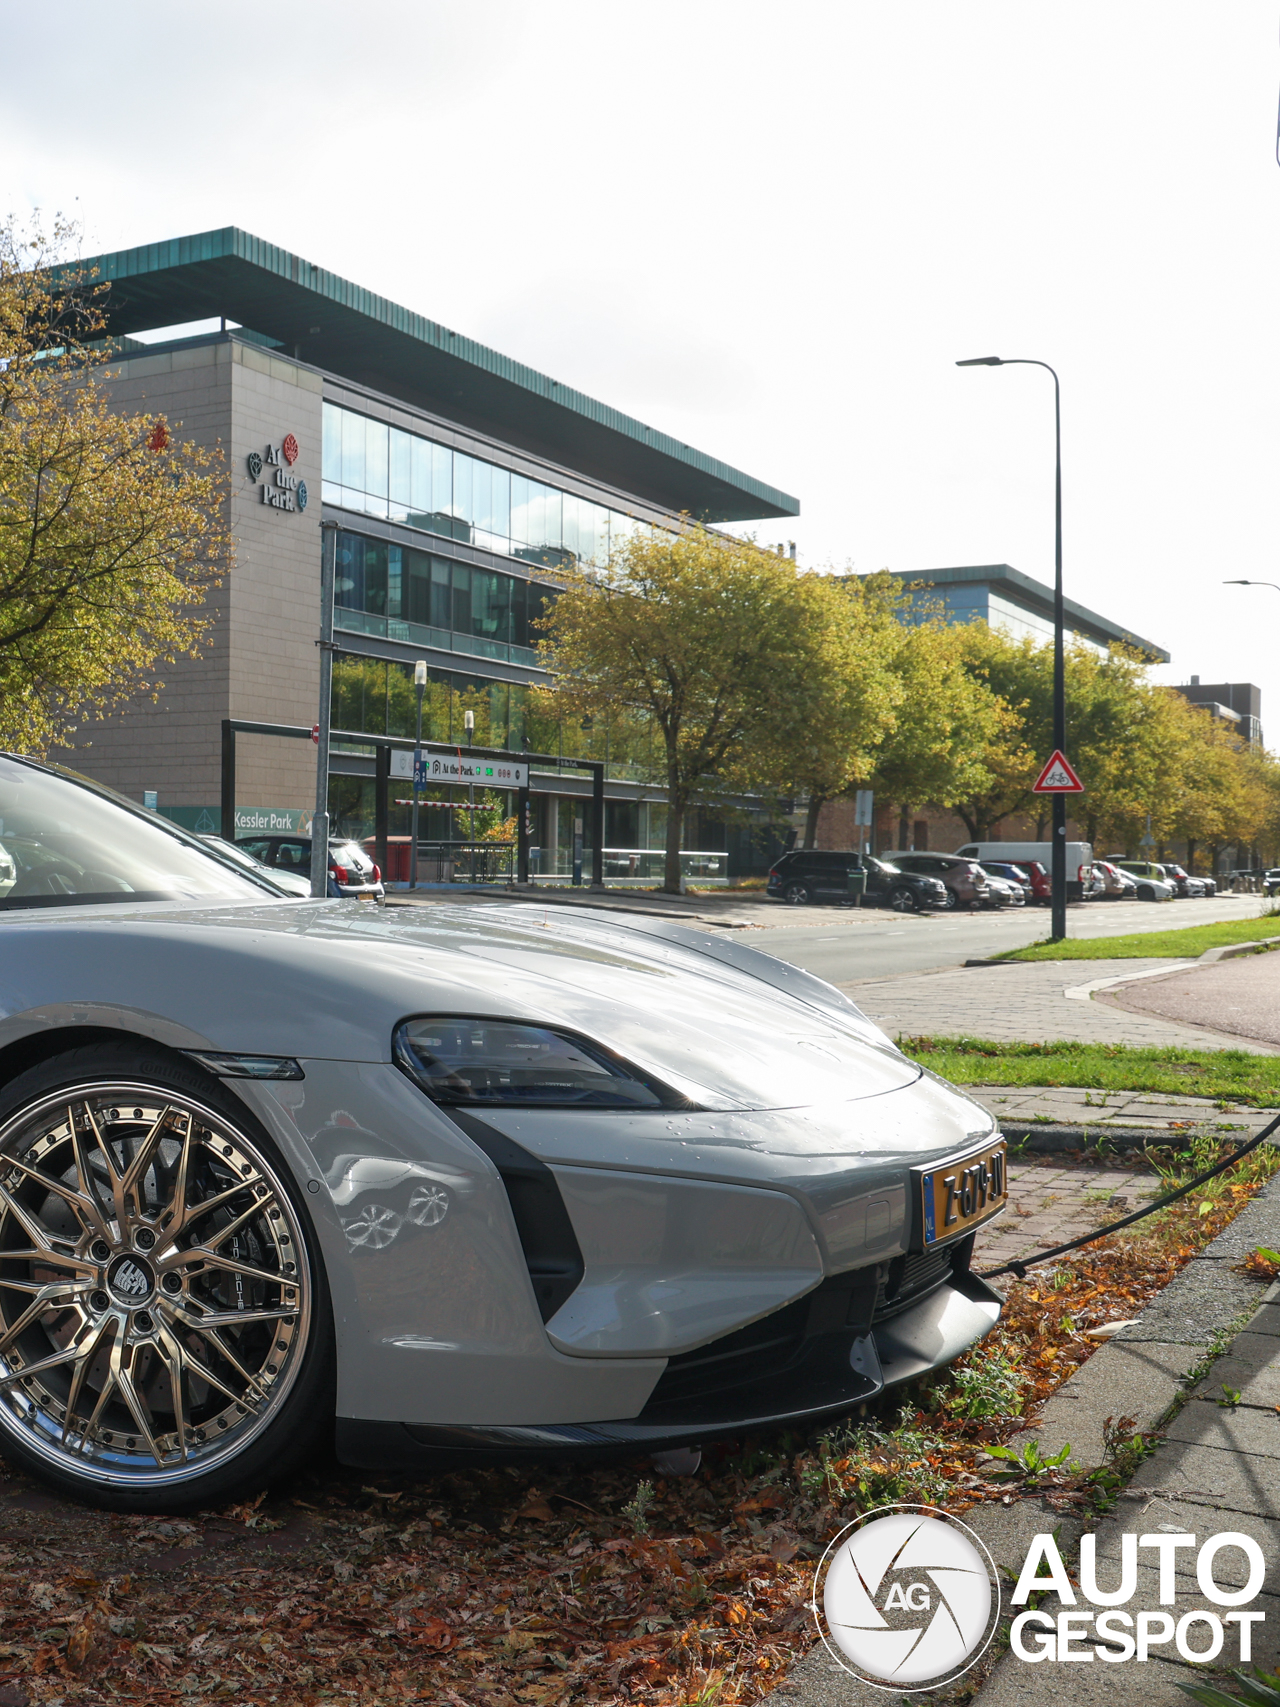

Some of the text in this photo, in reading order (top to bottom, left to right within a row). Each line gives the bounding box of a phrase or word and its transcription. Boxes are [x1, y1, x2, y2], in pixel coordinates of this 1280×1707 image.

[266, 443, 281, 466] At
[275, 467, 297, 491] the
[441, 763, 449, 774] At
[450, 764, 459, 775] the
[234, 811, 292, 830] Kessler Park
[139, 1061, 216, 1096] Continental
[925, 1216, 934, 1232] NL
[232, 1236, 245, 1310] POSCHE
